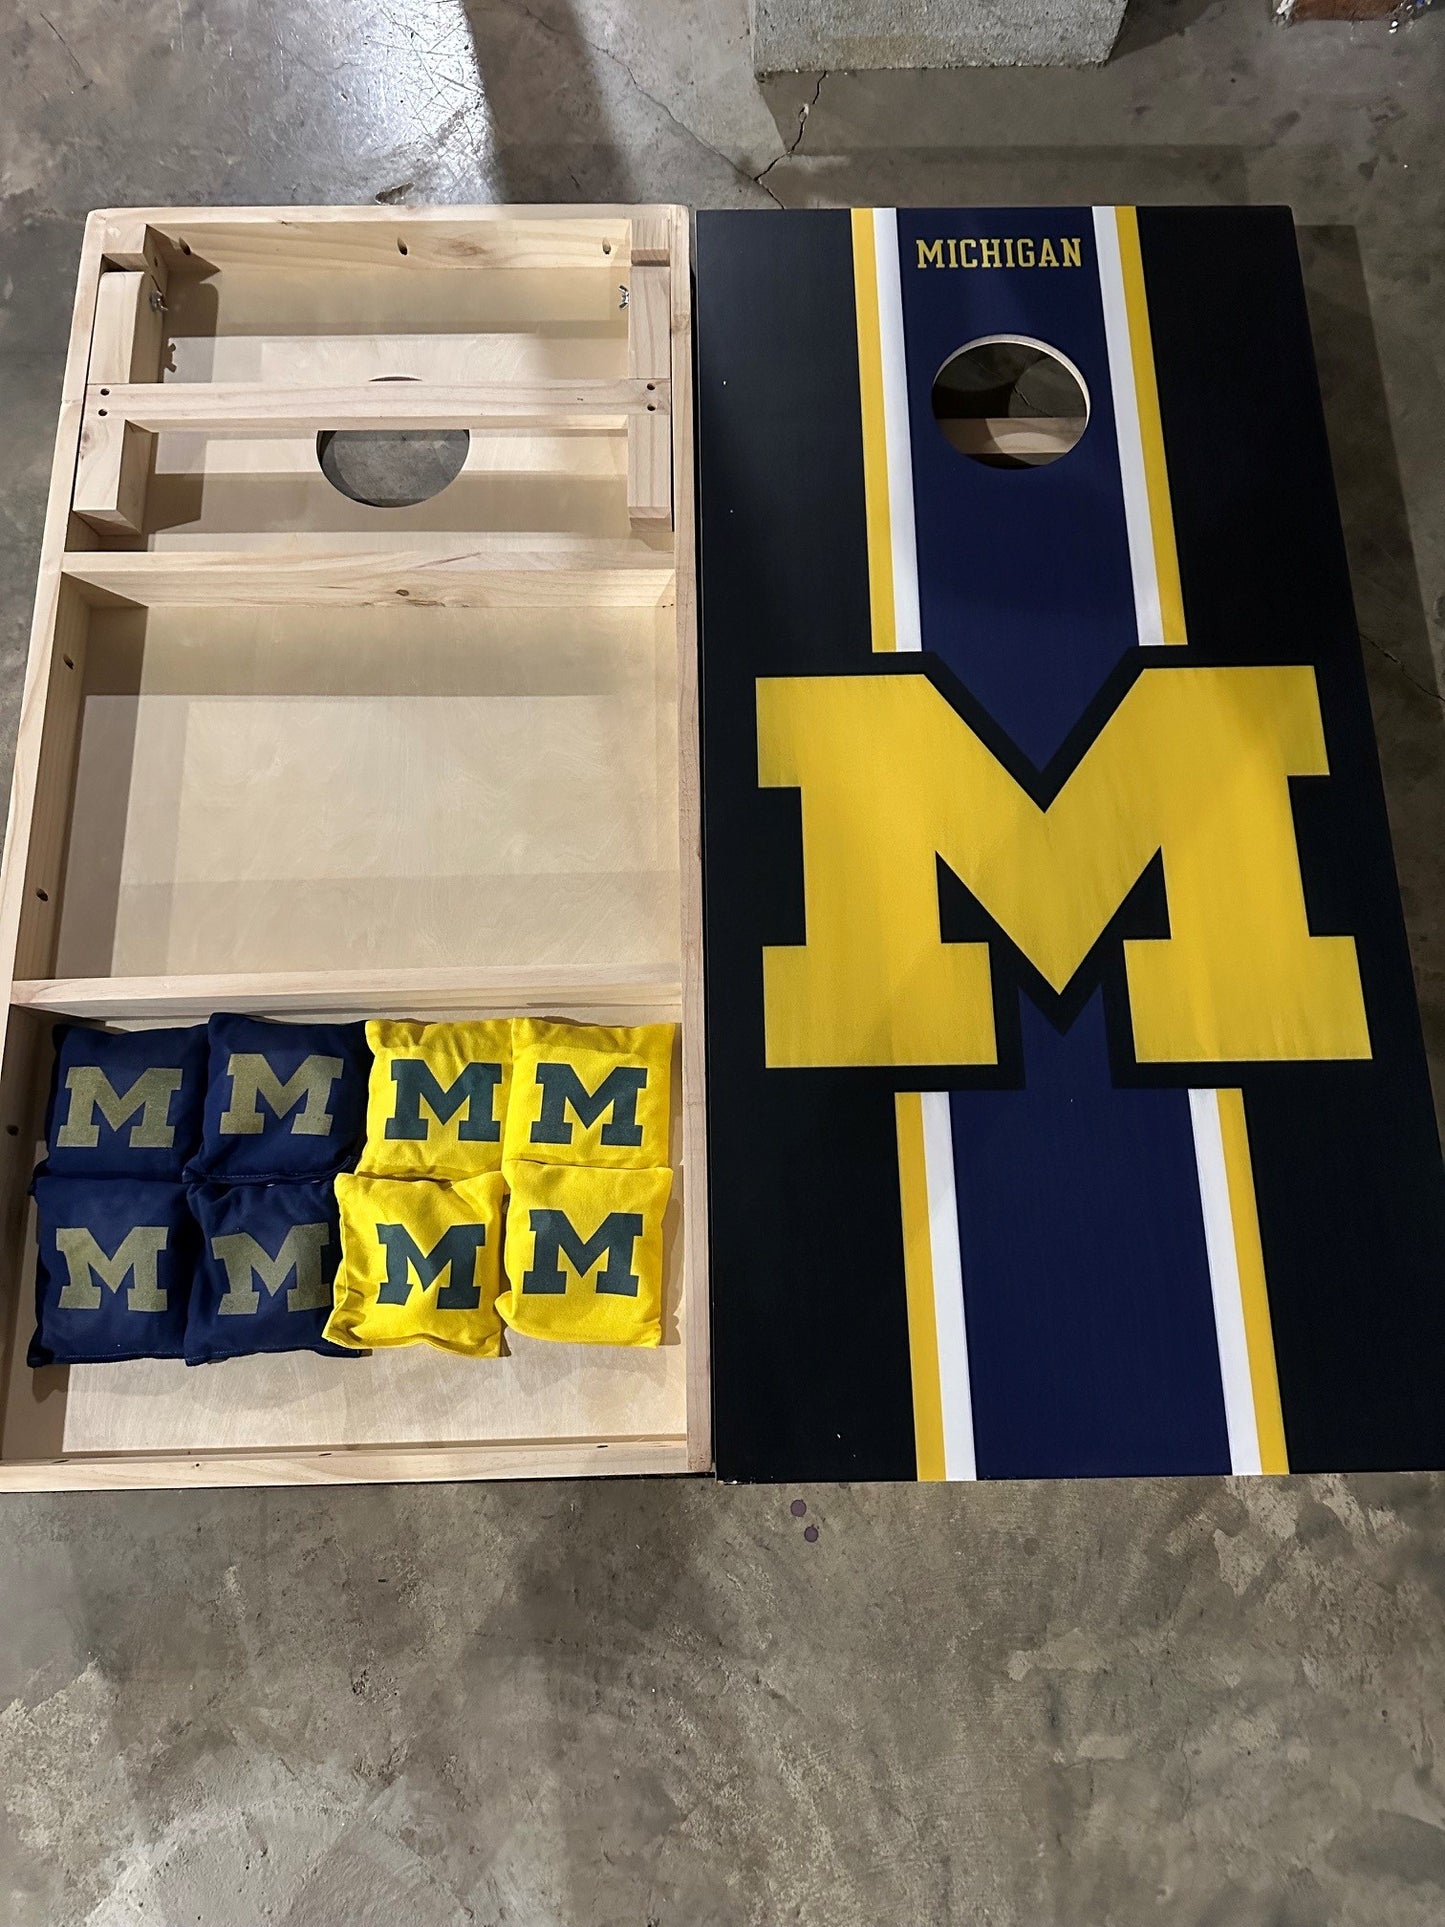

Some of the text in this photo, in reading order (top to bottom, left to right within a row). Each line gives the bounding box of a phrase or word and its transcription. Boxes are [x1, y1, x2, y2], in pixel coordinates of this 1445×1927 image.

[916, 238, 1082, 268] MICHIGAN
[755, 664, 1373, 1069] M
[57, 1067, 183, 1148] M
[219, 1053, 344, 1136] M
[384, 1058, 502, 1142] M
[529, 1062, 647, 1146] M
[55, 1226, 169, 1312] M
[211, 1222, 331, 1315] M
[376, 1223, 486, 1310] M
[522, 1209, 644, 1297] M
